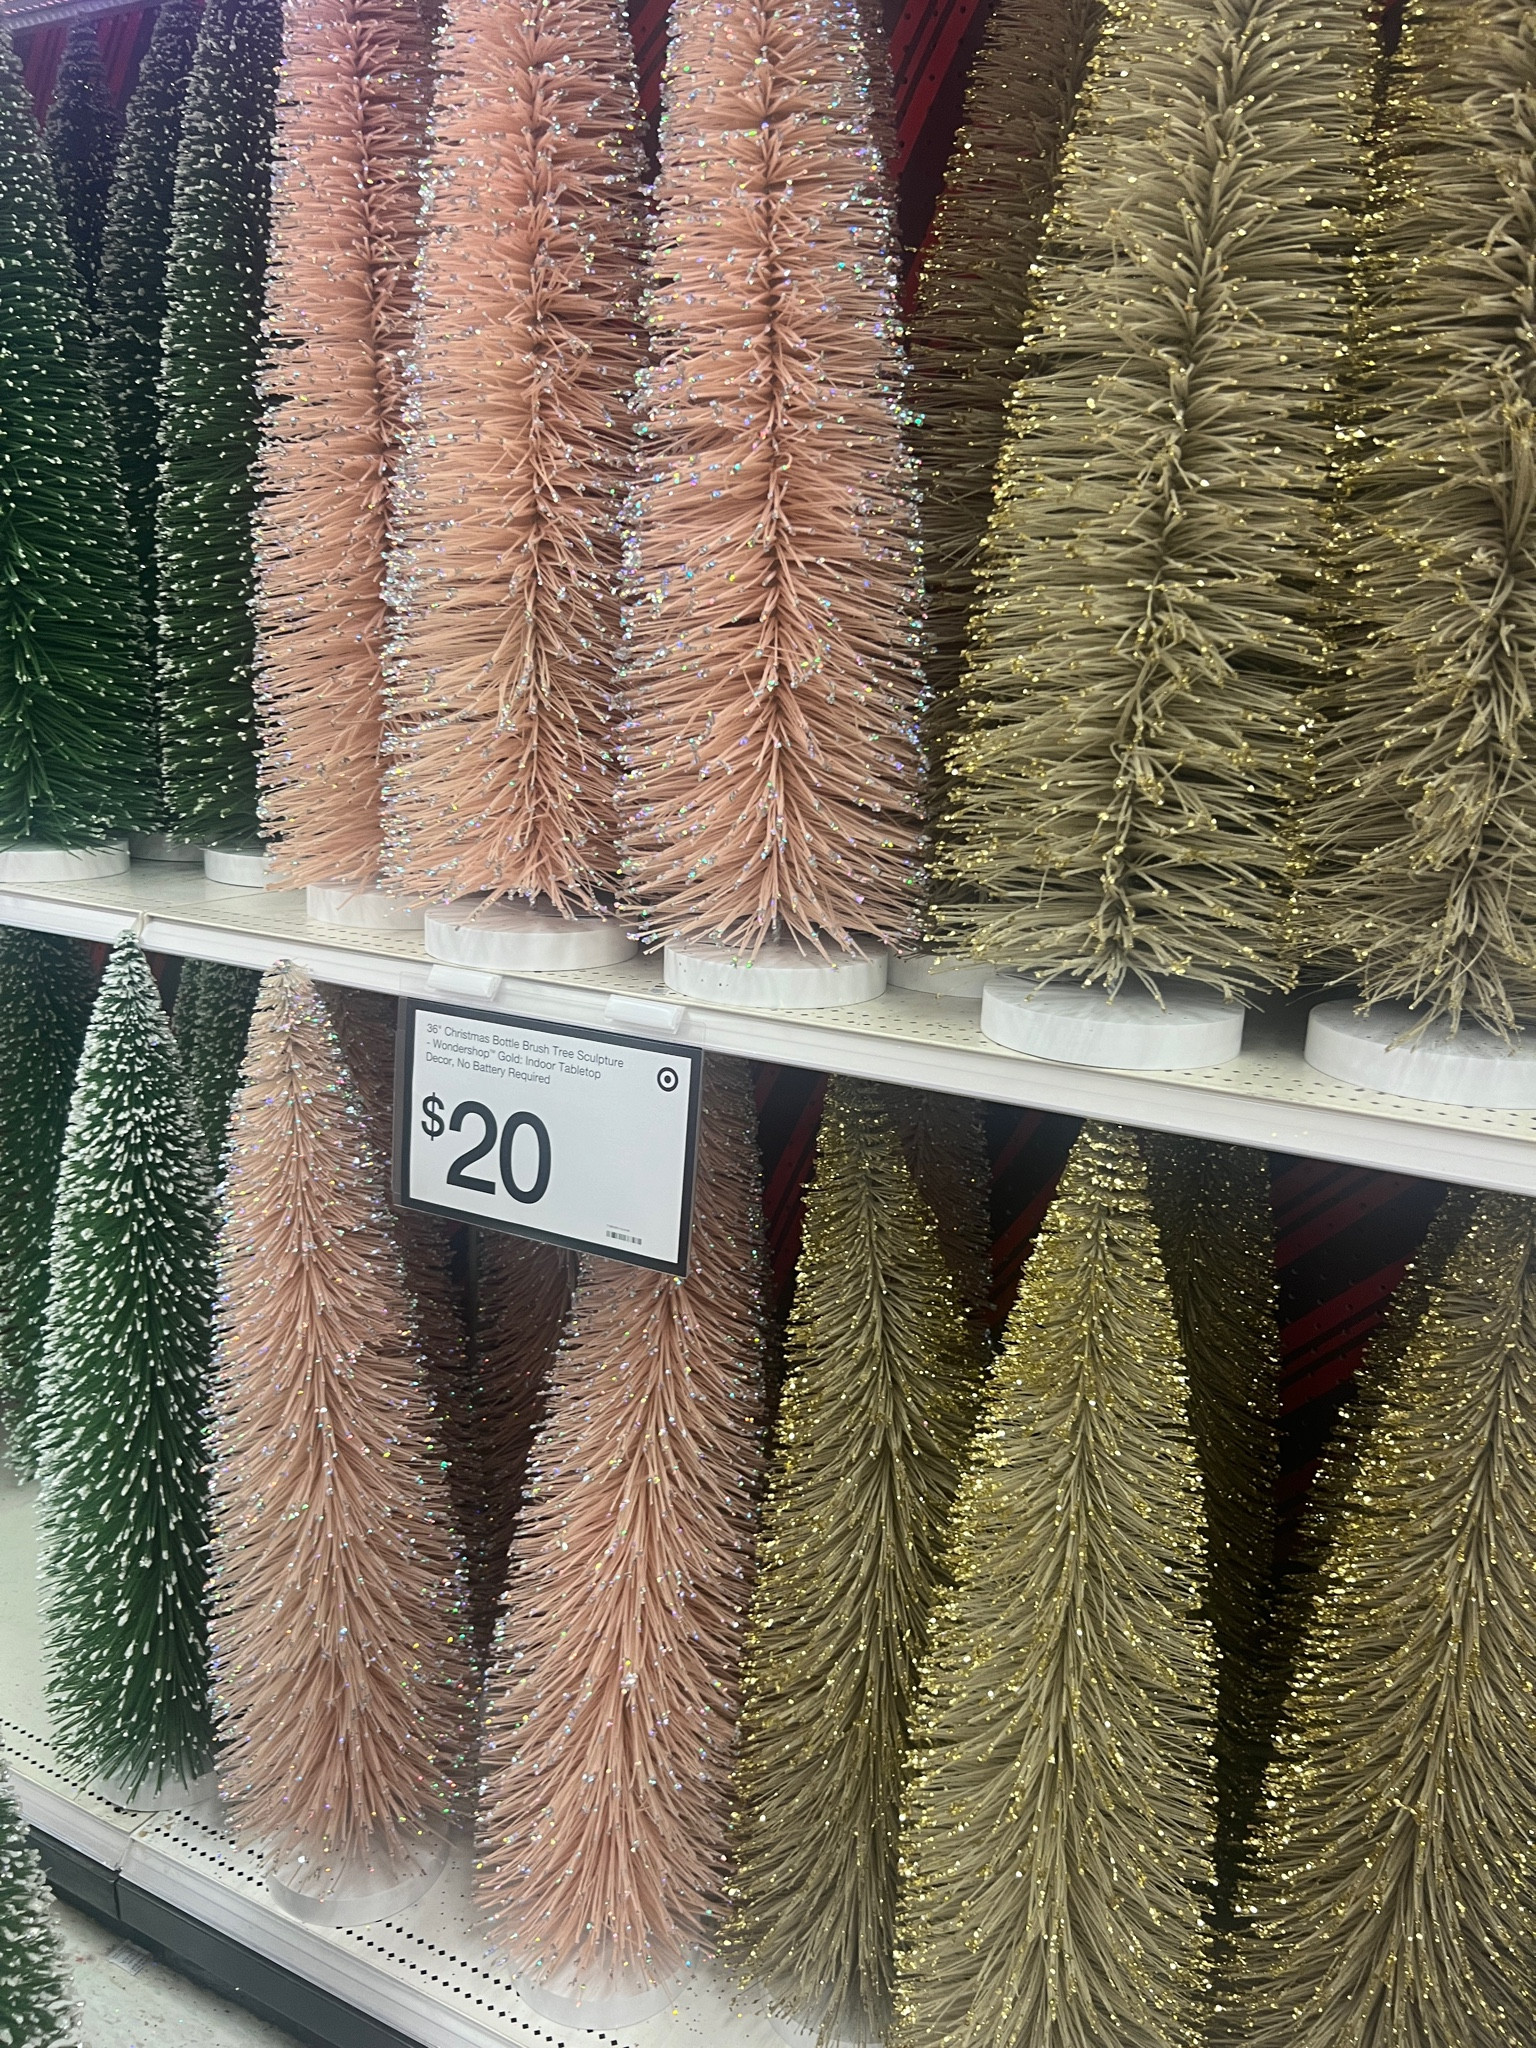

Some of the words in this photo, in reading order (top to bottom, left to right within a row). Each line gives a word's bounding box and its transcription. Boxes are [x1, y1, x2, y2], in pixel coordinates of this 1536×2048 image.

[444, 1026, 490, 1044] Christmas
[493, 1034, 520, 1049] Bottle
[522, 1040, 550, 1055] Brush
[553, 1046, 575, 1059] Tree
[577, 1050, 624, 1069] Sculpture
[498, 1051, 523, 1065] Gold:
[525, 1056, 556, 1071] Indoor
[559, 1062, 601, 1080] Tabletop
[426, 1051, 454, 1068] Decor,
[457, 1057, 470, 1069] No
[473, 1060, 506, 1079] Battery
[508, 1068, 550, 1085] Required
[421, 1092, 552, 1205] $20
